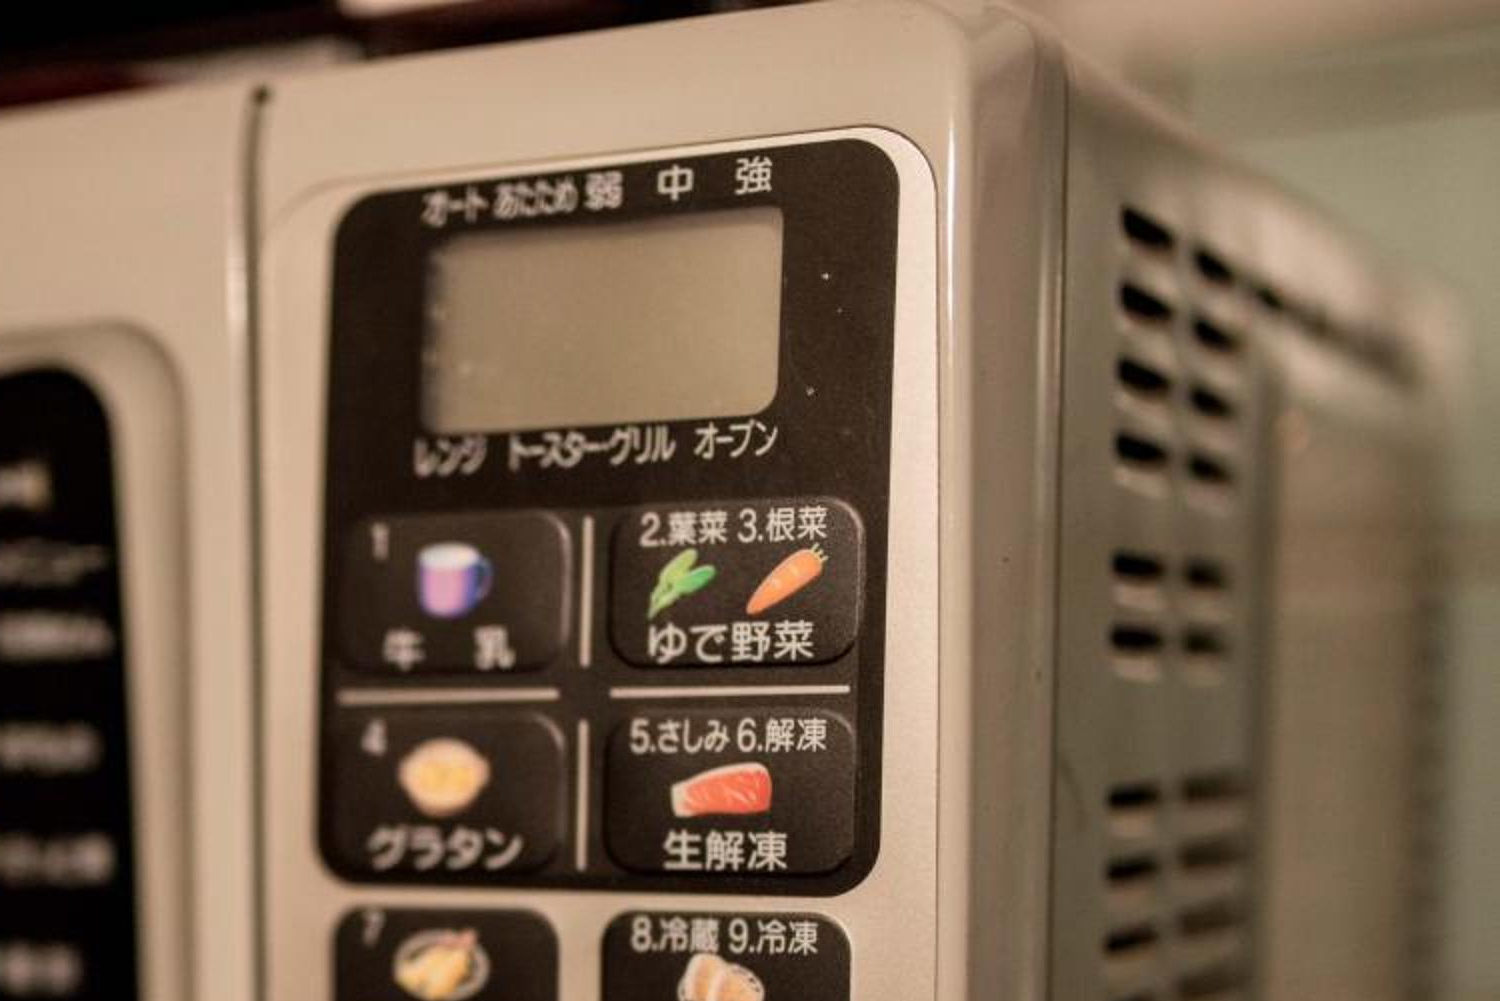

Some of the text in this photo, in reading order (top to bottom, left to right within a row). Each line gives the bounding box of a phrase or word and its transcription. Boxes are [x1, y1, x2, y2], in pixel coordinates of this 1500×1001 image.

[657, 164, 695, 202] 中
[733, 156, 774, 196] 強
[413, 435, 487, 478] レンジ
[693, 419, 779, 461] オープン
[370, 521, 391, 560] 1
[639, 505, 828, 547] 2.葉菜 3.根菜
[647, 619, 815, 664] ゆで野菜
[361, 719, 389, 758] 4
[629, 717, 828, 755] 5.さしみ 6.解凍
[367, 826, 524, 870] グラタン
[662, 828, 788, 873] 生解凍
[630, 918, 819, 957] 8.冷蔵 9.冷凍
